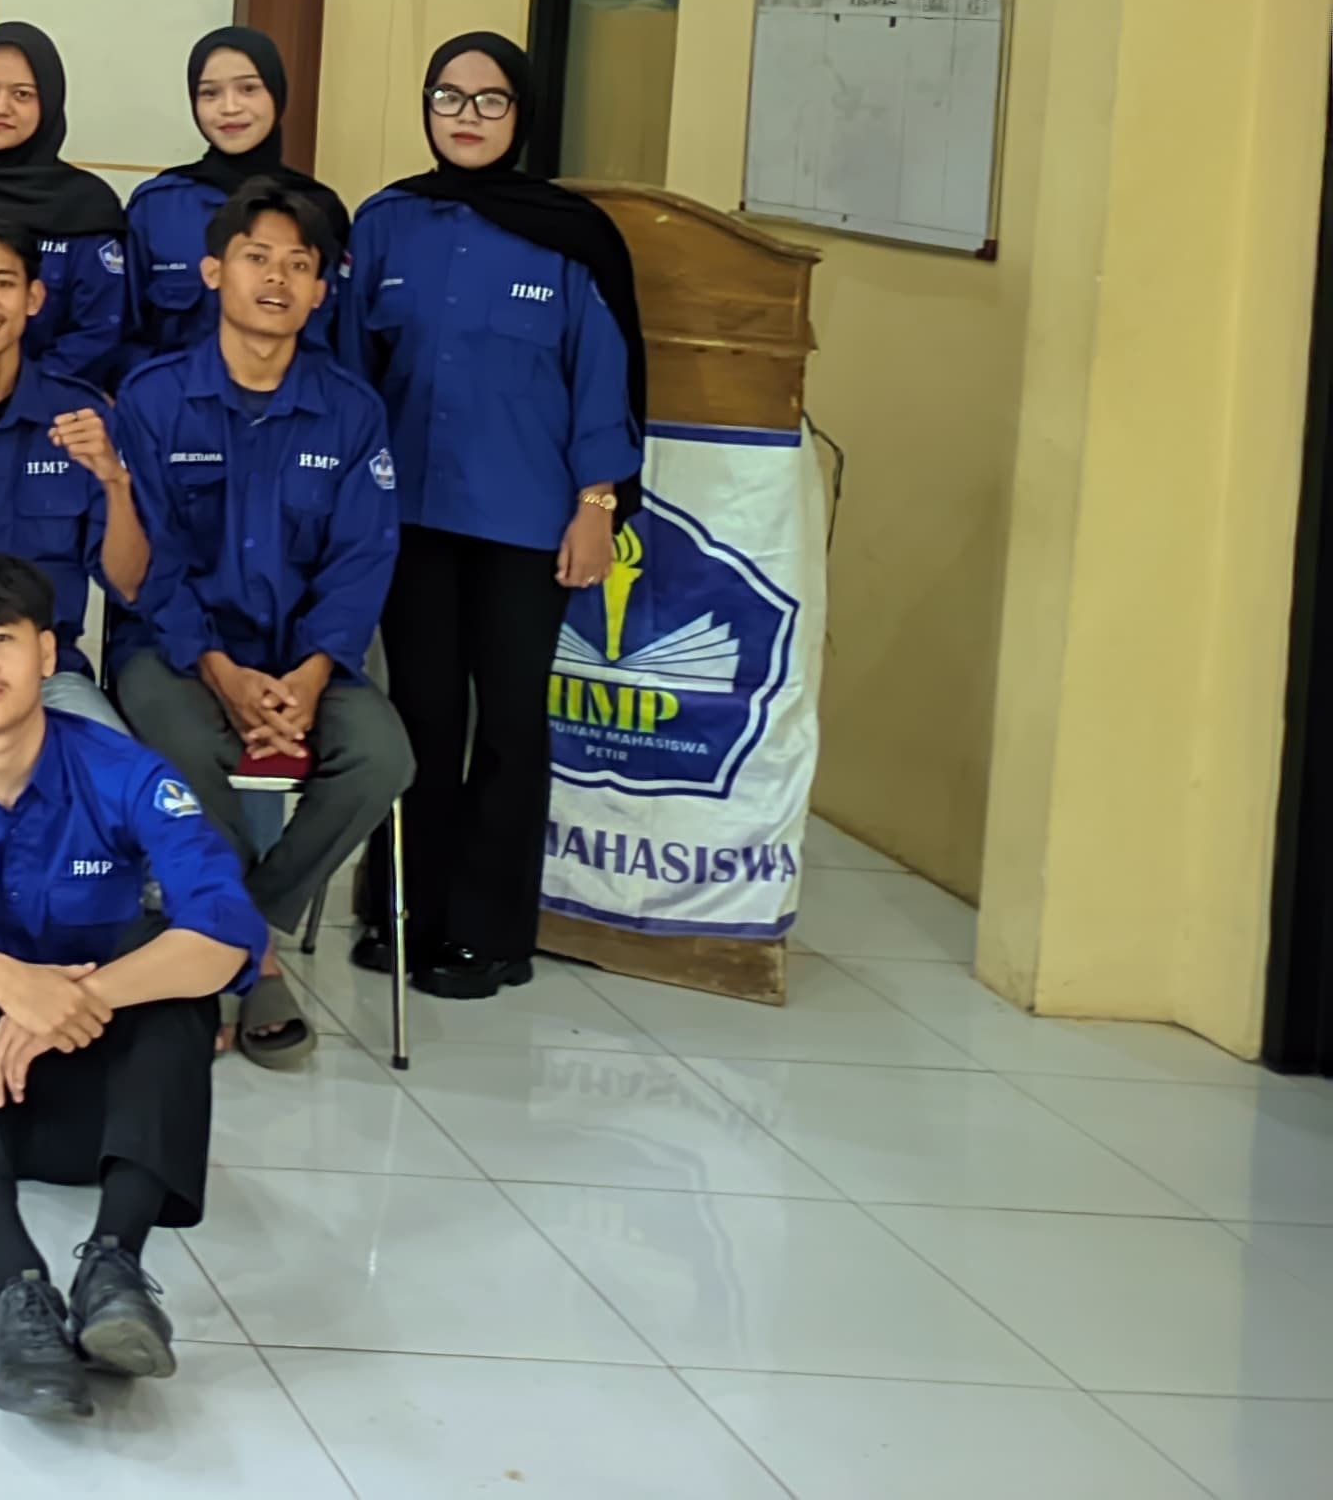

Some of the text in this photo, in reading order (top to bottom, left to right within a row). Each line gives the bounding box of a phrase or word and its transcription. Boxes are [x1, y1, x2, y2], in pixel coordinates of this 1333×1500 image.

[511, 283, 554, 302] HMP
[27, 461, 70, 475] HMP
[299, 453, 340, 471] HMP
[548, 674, 679, 734] HMP
[605, 731, 708, 755] MAHASISWA
[585, 744, 629, 762] PETIR
[73, 860, 113, 876] HMP
